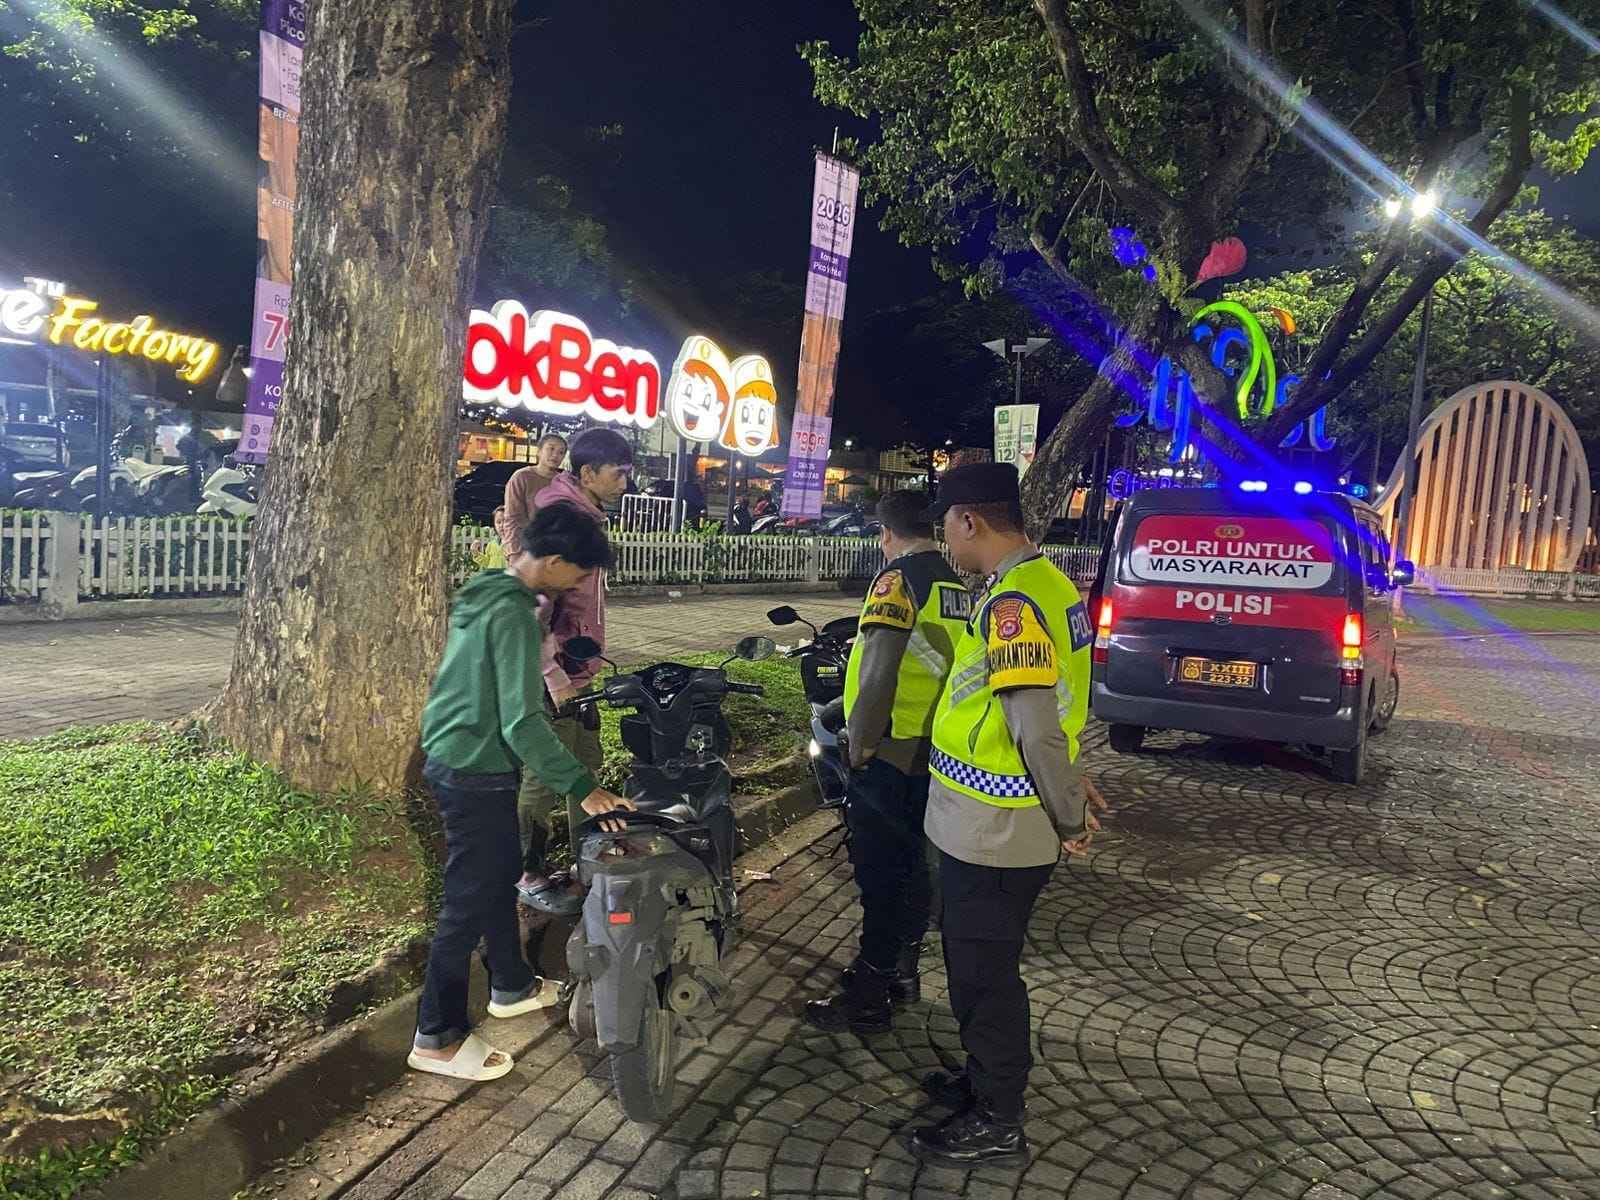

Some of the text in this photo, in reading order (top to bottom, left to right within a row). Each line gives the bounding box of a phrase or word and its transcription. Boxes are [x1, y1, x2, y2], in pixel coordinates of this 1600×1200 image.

[816, 194, 850, 227] 2026
[49, 295, 218, 384] Factory
[1148, 539, 1315, 560] POLRI UNTUK
[1149, 557, 1313, 578] MASYARAKAT
[1175, 590, 1273, 616] POLISI
[1210, 674, 1250, 685] 223-32
